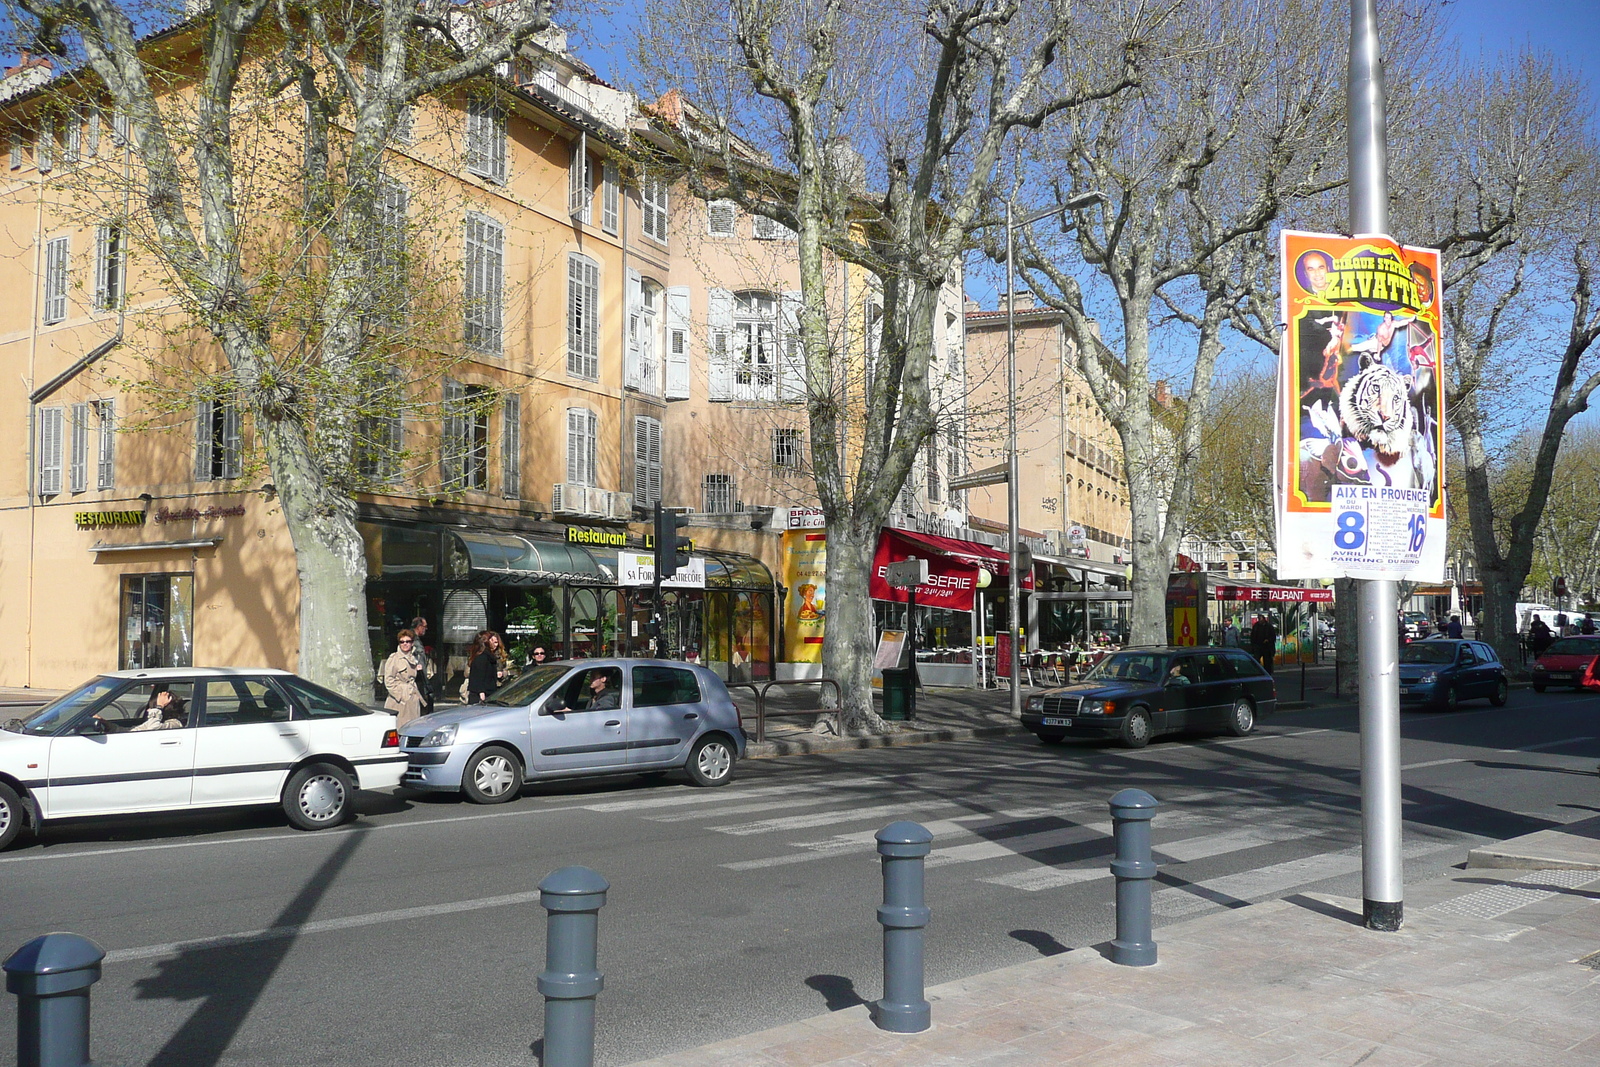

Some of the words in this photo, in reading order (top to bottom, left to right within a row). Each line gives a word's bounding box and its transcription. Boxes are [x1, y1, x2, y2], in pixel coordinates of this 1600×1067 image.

[1333, 257, 1375, 270] CIRQUE
[1326, 270, 1421, 309] ZAVATTA
[1336, 487, 1357, 498] AIX
[1361, 487, 1377, 498] EN
[1381, 488, 1427, 502] PROVENCE
[74, 511, 143, 525] RESTAURANT
[568, 527, 627, 546] Restaurant
[1334, 511, 1365, 550] 8
[1407, 513, 1425, 552] 16
[1251, 590, 1304, 600] RESTAURANT
